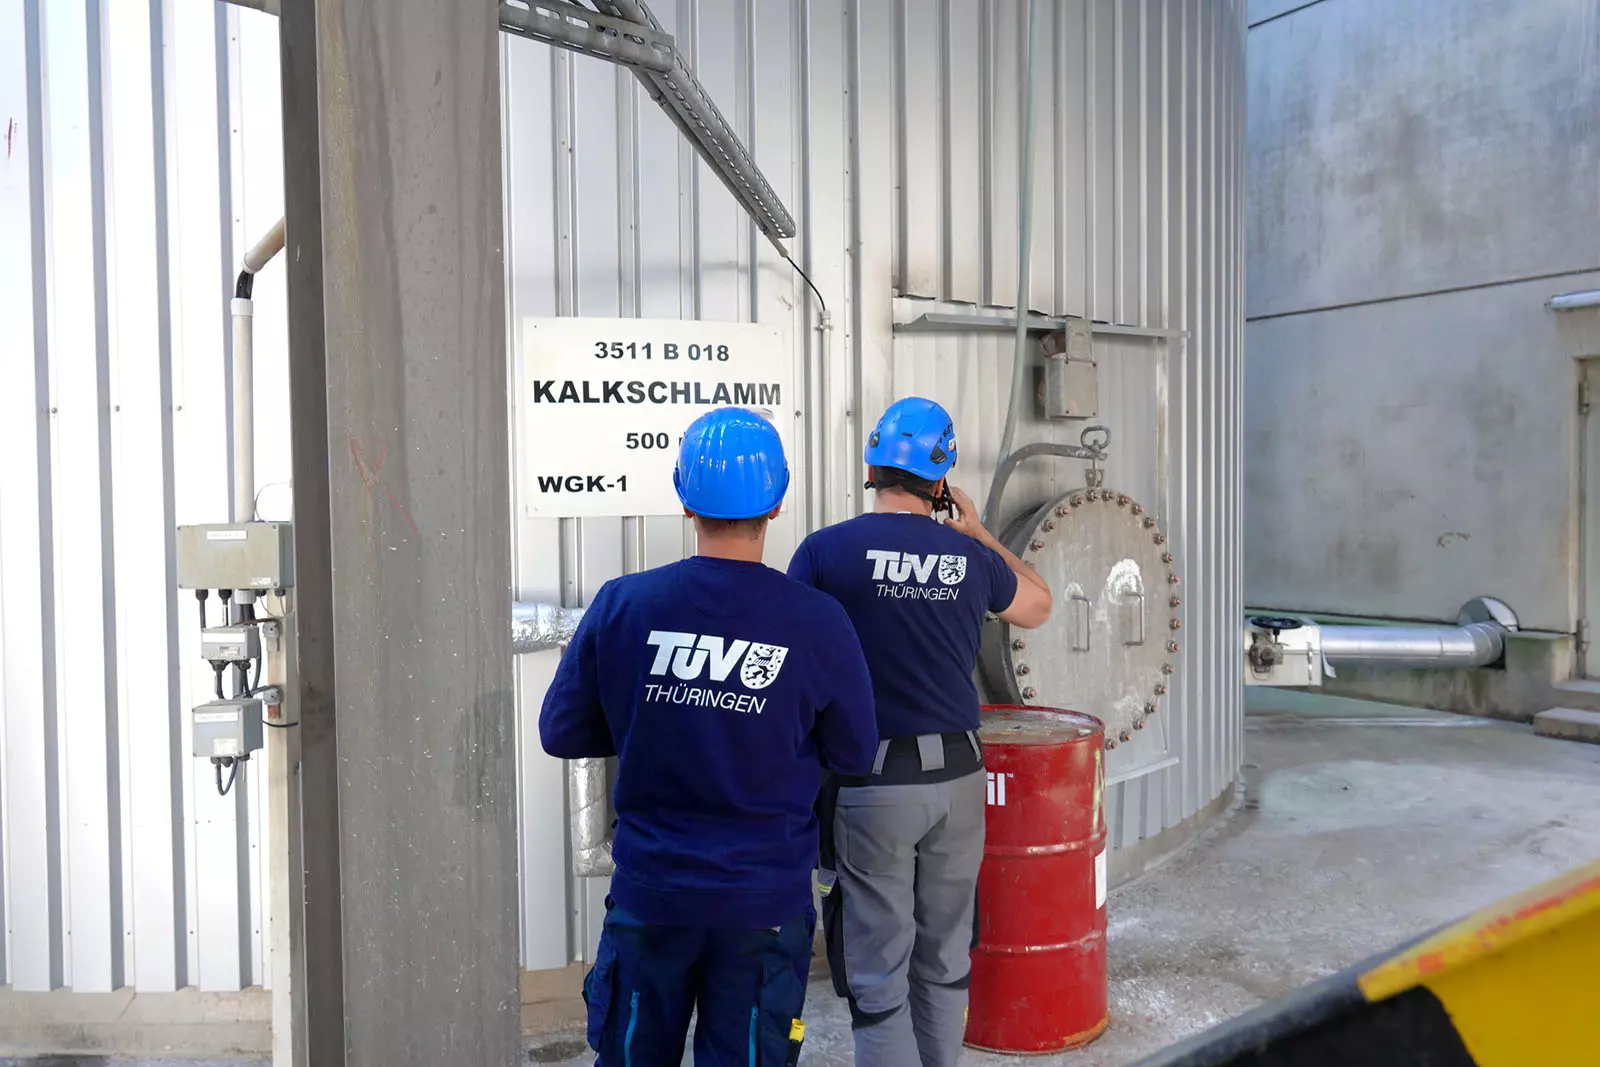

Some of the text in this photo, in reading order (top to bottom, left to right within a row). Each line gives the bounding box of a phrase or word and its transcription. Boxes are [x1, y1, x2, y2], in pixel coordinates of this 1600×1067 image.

[594, 341, 730, 362] 3511 B 018
[533, 380, 781, 405] KALKSCHLAMM
[625, 432, 670, 450] 500
[537, 474, 628, 493] WGK-1
[876, 584, 960, 601] THÜRINGEN
[645, 683, 767, 714] THÜRINGEN
